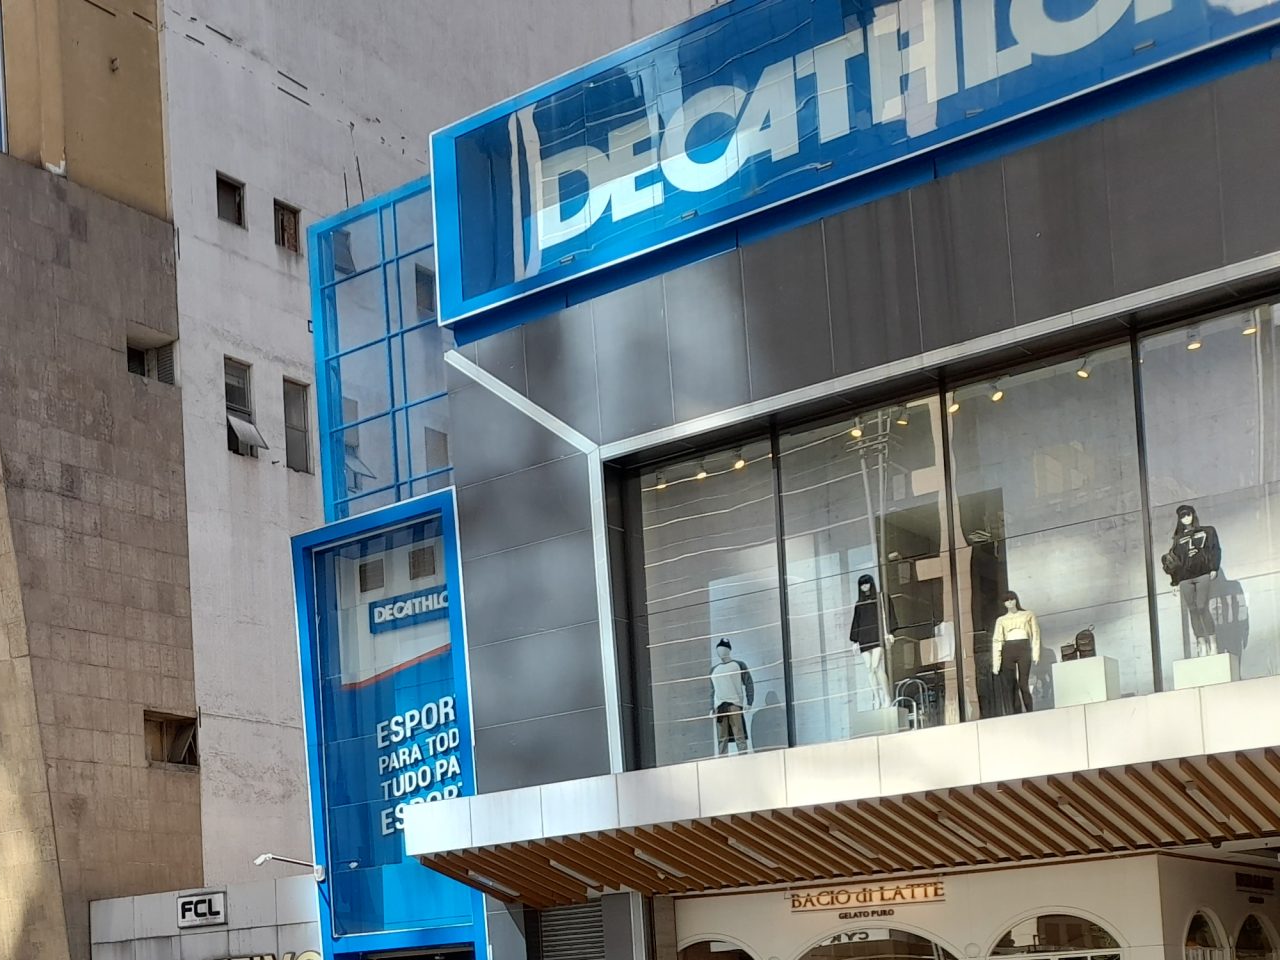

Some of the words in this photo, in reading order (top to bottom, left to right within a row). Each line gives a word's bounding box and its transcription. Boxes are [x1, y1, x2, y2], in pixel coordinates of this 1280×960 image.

[537, 0, 1170, 250] DECATHLO
[376, 693, 456, 749] ESPOR
[378, 741, 420, 776] PARA
[381, 765, 431, 801] TUDO
[181, 898, 221, 919] FCL
[791, 889, 851, 909] BACIO
[856, 887, 873, 903] di
[879, 881, 945, 902] LATTE
[838, 911, 870, 920] GELATO
[871, 909, 894, 918] PURO
